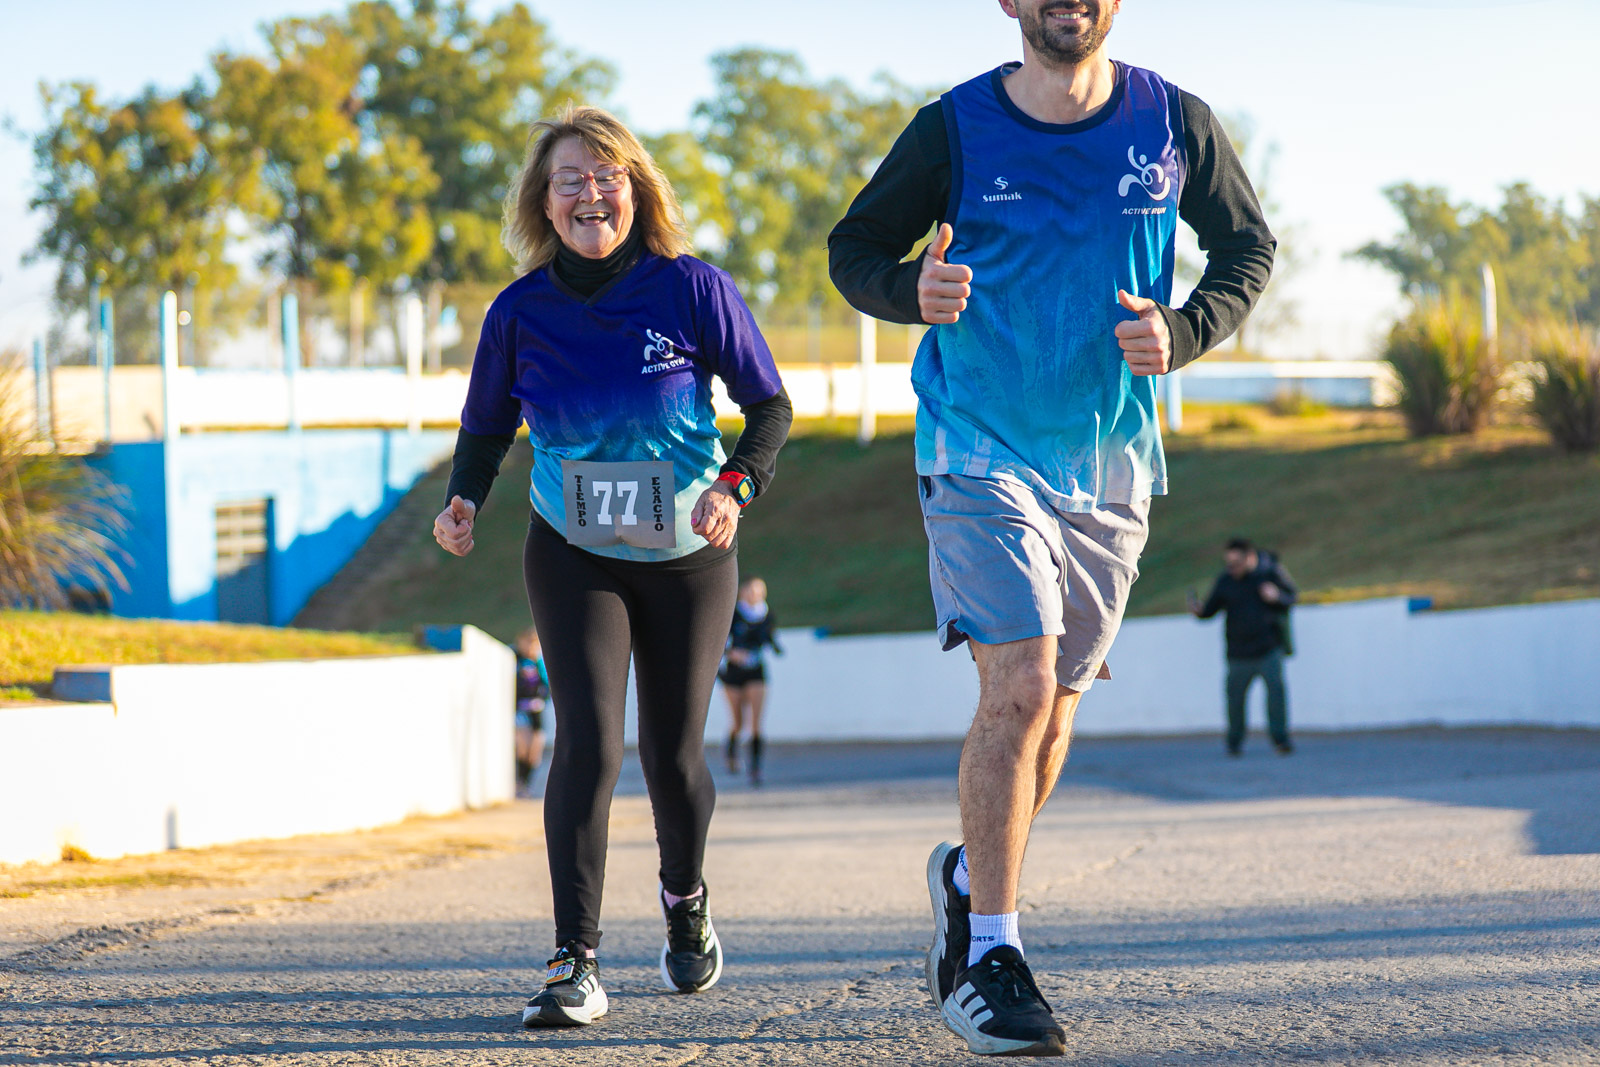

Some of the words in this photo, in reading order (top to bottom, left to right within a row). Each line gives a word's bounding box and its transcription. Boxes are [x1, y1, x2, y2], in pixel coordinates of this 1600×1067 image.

[1151, 206, 1167, 215] RUN
[641, 362, 670, 374] ACTIVE
[669, 356, 685, 368] GYM
[574, 475, 587, 527] TIEMPO
[592, 481, 639, 526] 77
[651, 477, 664, 532] EXACTO
